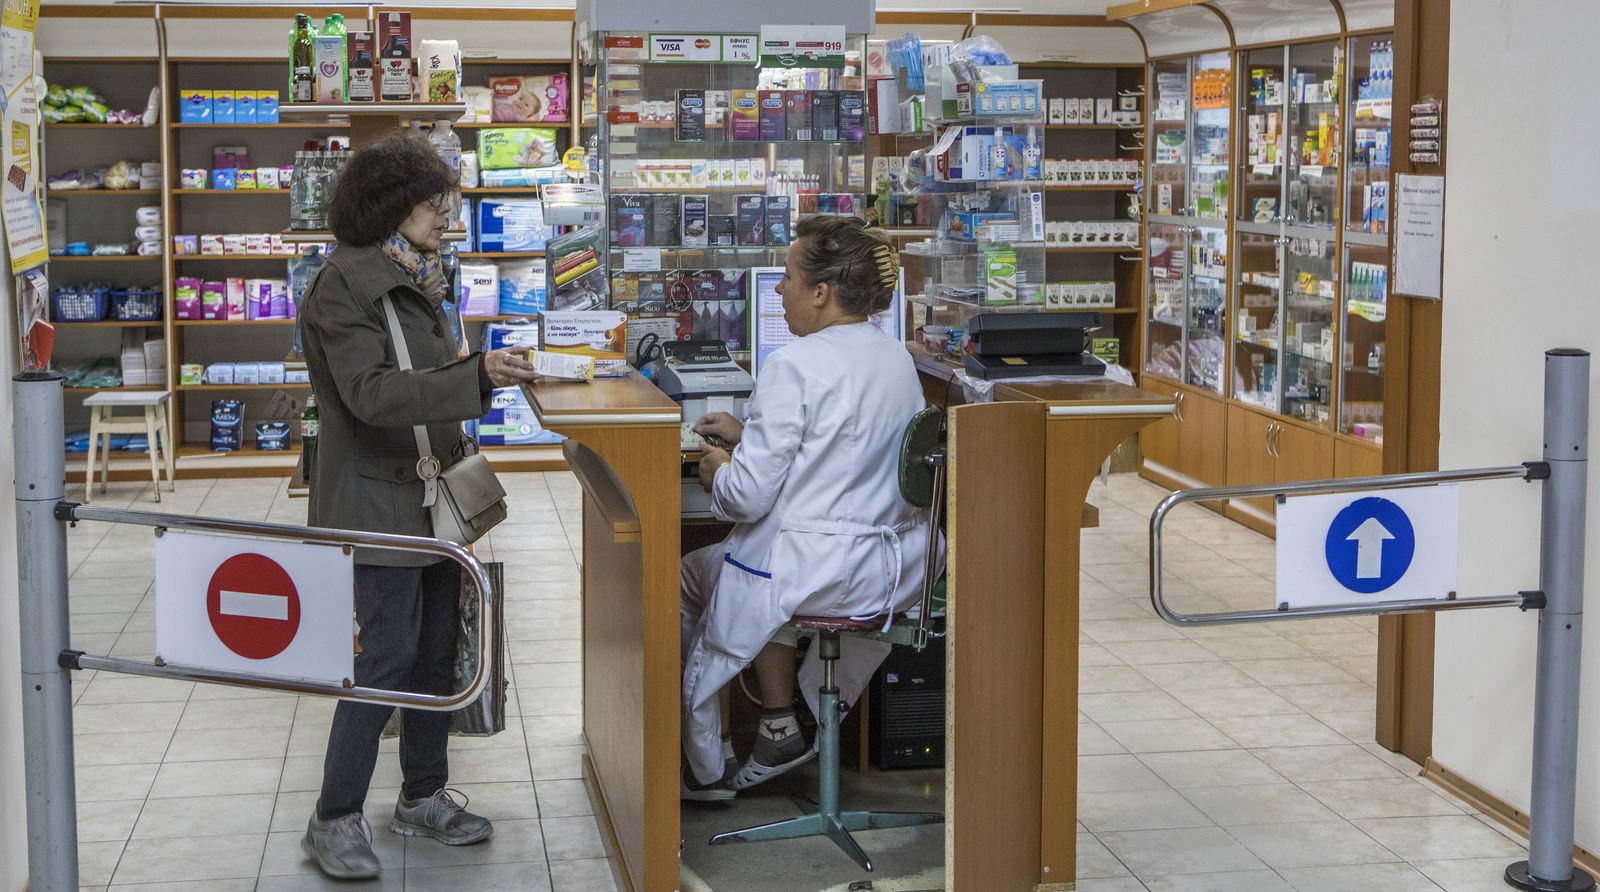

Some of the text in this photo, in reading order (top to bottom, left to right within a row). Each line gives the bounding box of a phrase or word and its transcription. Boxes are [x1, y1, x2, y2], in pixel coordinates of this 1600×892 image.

[660, 43, 681, 51] VISA
[824, 42, 842, 51] 919
[741, 52, 751, 60] %
[622, 196, 641, 208] Viva
[215, 413, 236, 421] MEN
[506, 411, 521, 421] Slip
